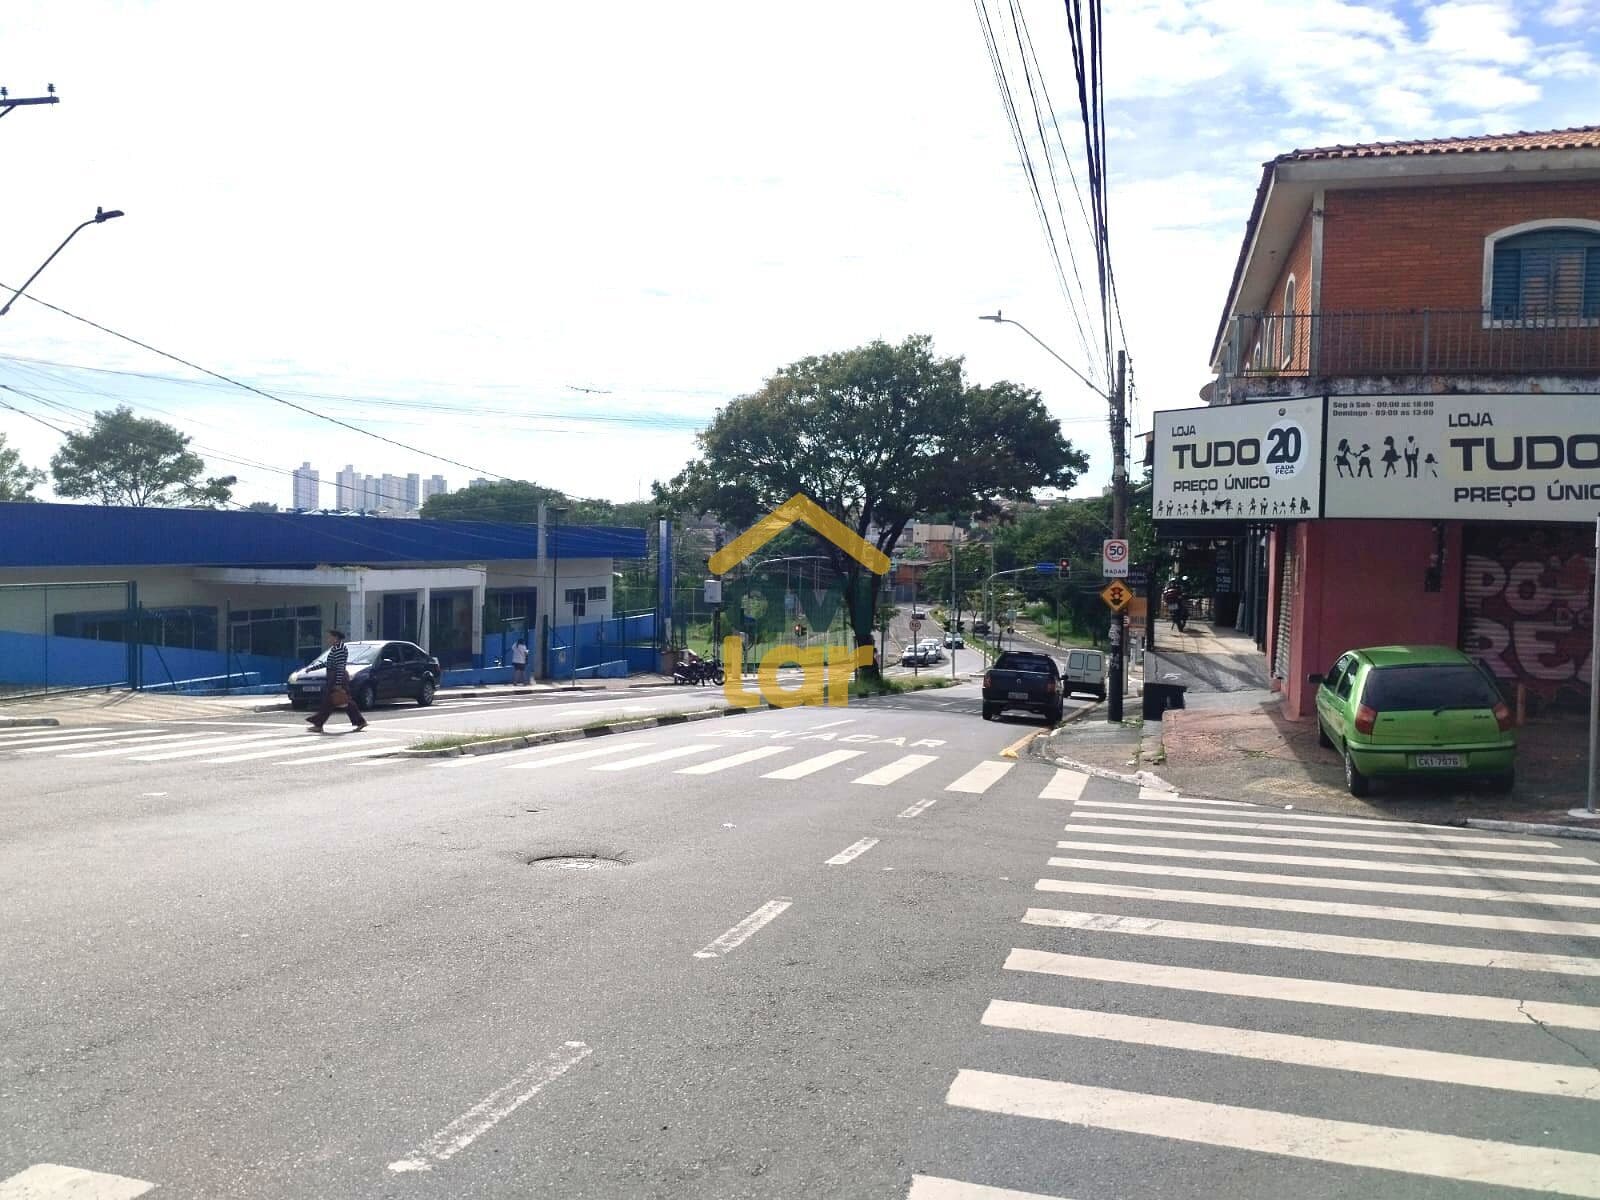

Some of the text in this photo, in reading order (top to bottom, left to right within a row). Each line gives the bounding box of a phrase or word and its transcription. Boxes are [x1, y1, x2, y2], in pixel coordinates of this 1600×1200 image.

[1448, 412, 1493, 428] LOJA
[1171, 425, 1196, 438] LOJA
[1172, 438, 1260, 470] TUDO
[1266, 427, 1302, 464] 20
[1450, 435, 1600, 471] TUDO
[1173, 474, 1270, 496] PREÇO ÚNICO
[1454, 485, 1536, 507] PREÇO
[1109, 546, 1123, 556] 50
